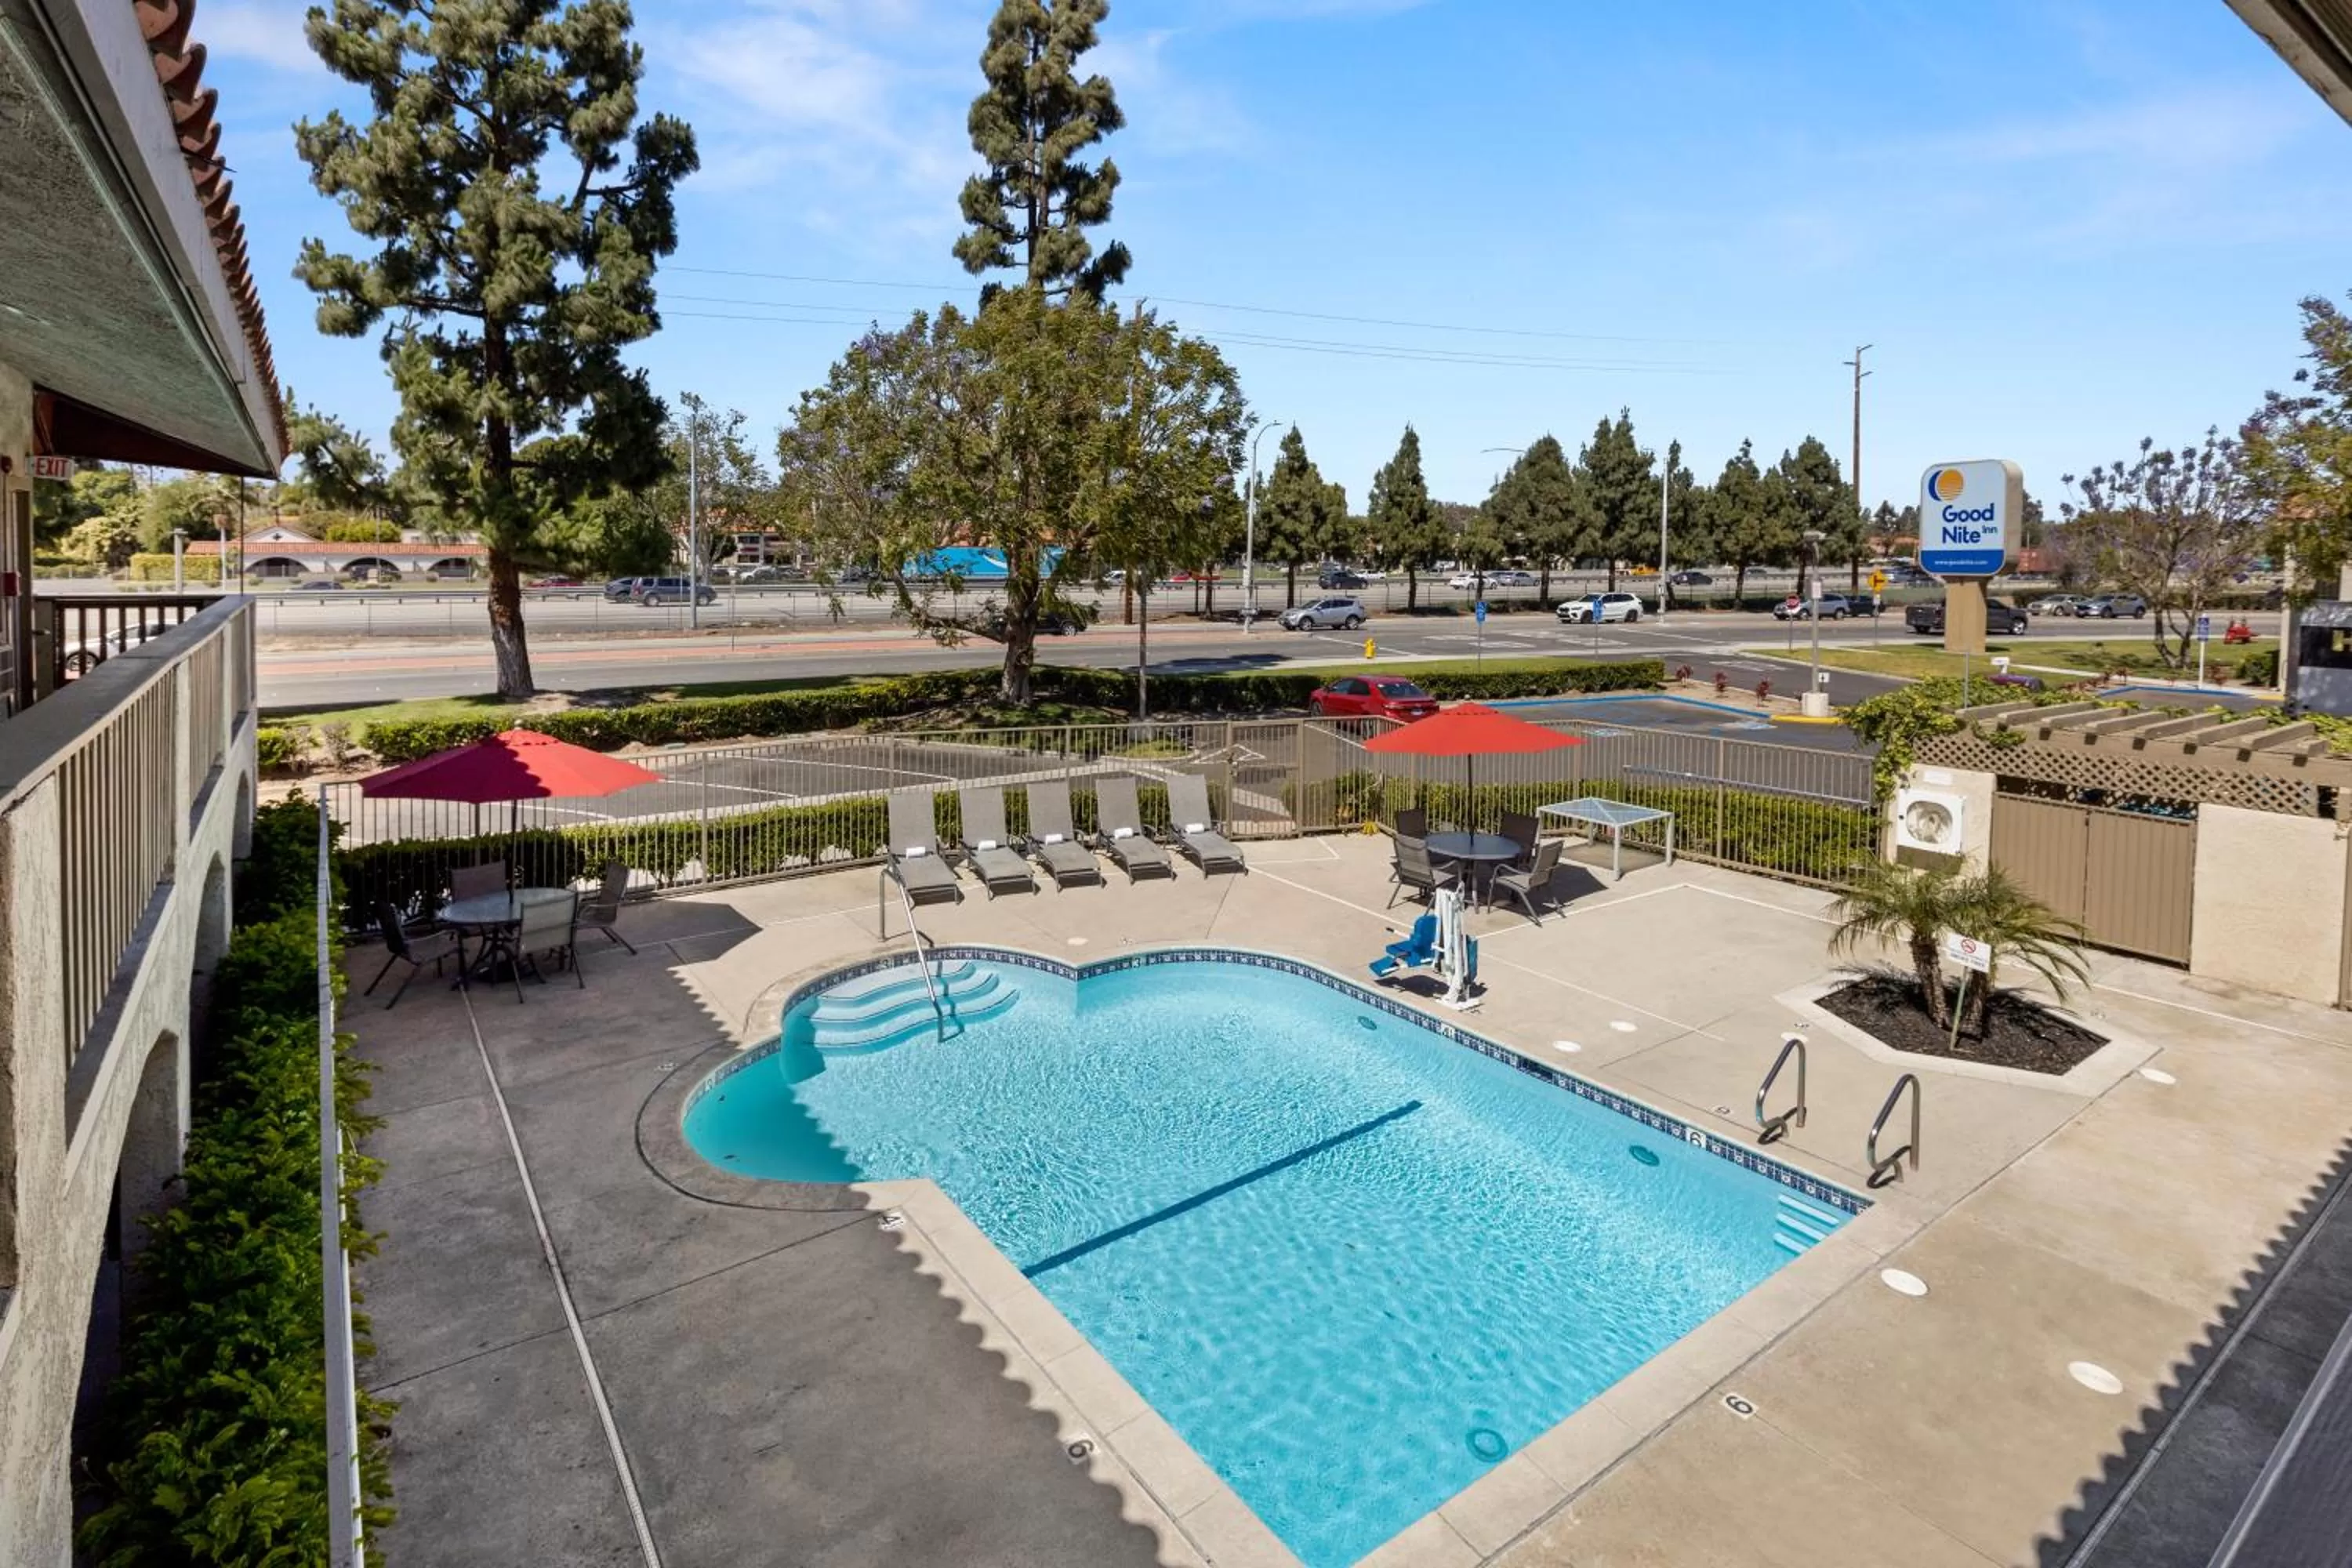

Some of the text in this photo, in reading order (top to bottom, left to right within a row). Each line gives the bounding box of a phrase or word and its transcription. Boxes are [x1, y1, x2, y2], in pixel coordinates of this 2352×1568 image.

[34, 457, 69, 477] EXIT
[1942, 503, 1994, 523] Good
[1942, 524, 1998, 543] Nite Inn
[1690, 1131, 1702, 1148] 6
[1726, 1396, 1753, 1414] 6
[1068, 1439, 1094, 1458] 6
